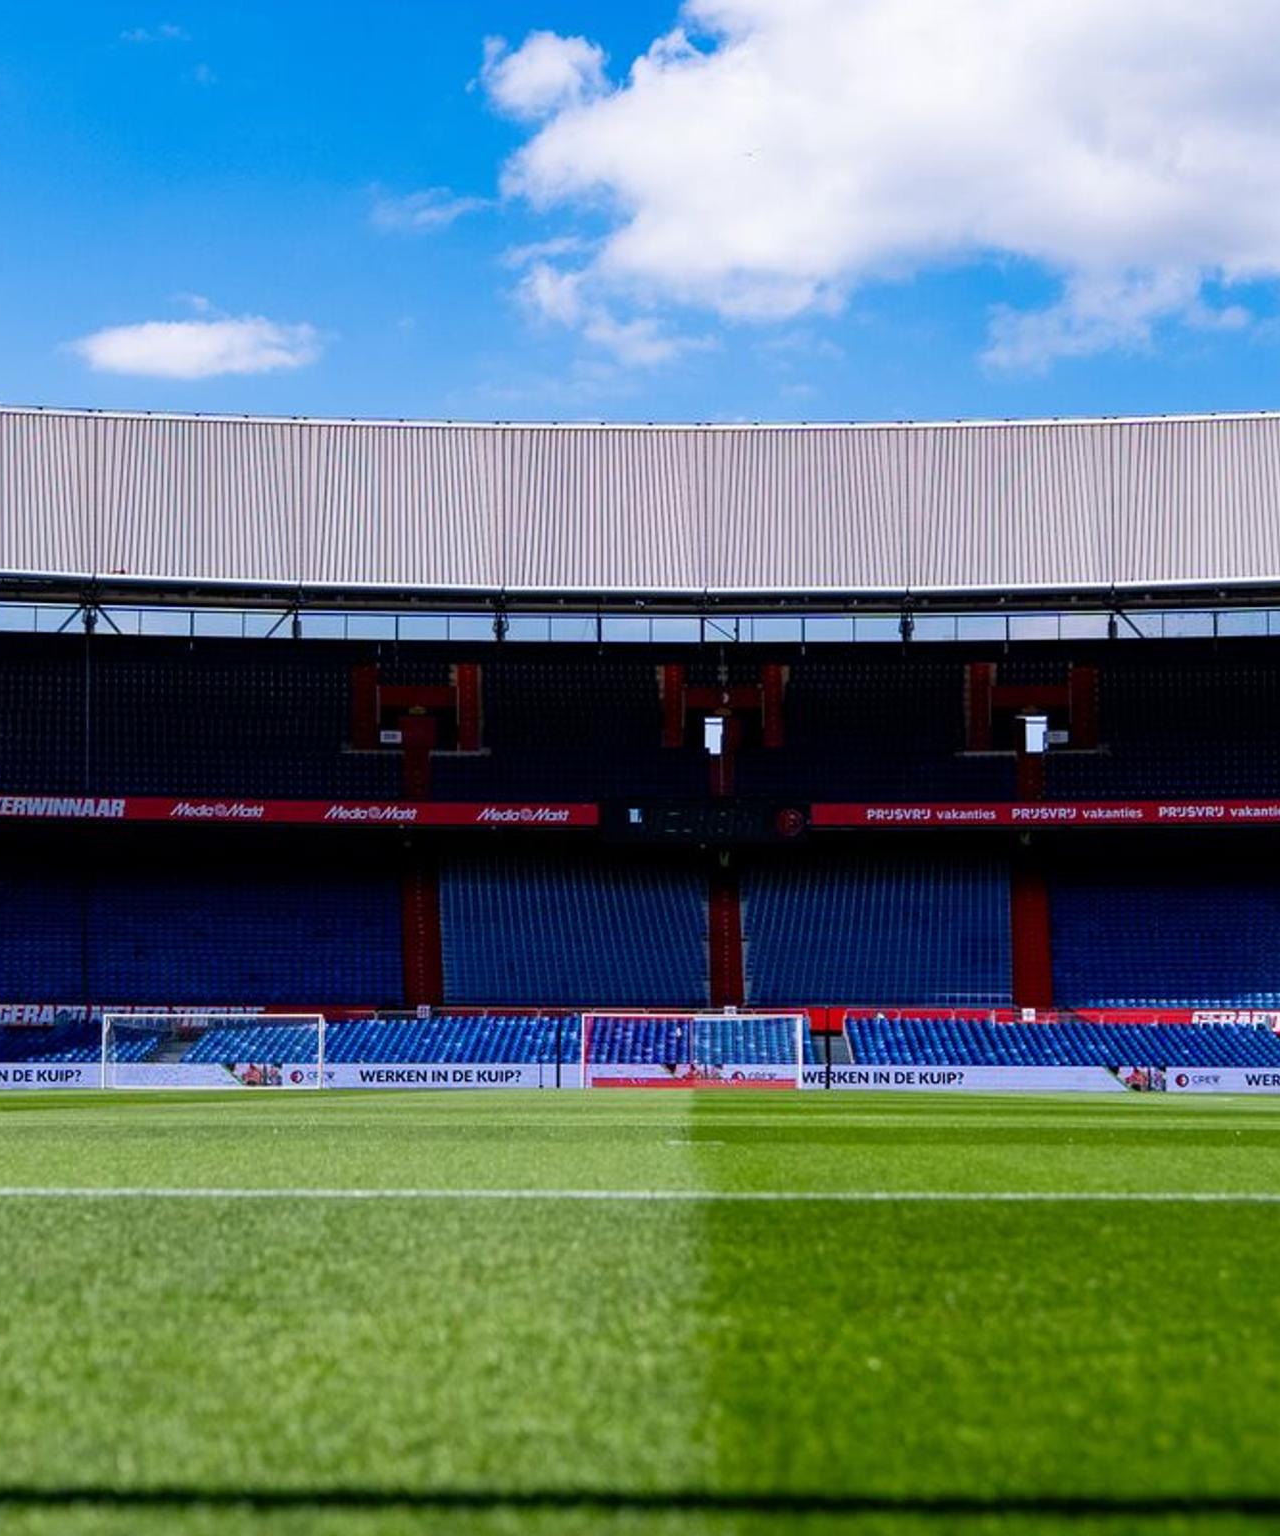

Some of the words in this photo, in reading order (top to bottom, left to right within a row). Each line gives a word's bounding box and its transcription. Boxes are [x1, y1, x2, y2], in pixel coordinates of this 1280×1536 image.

[936, 809, 996, 820] vakanties
[1082, 807, 1143, 819] vakanties
[13, 1069, 32, 1082] DE
[36, 1069, 81, 1082] KUIP?
[359, 1070, 427, 1082] WERKEN
[432, 1070, 447, 1082] IN
[453, 1070, 473, 1082] DE
[477, 1070, 521, 1082] KUIP?
[873, 1072, 889, 1084] IN
[895, 1072, 914, 1084] DE
[919, 1072, 964, 1084] KUIP?
